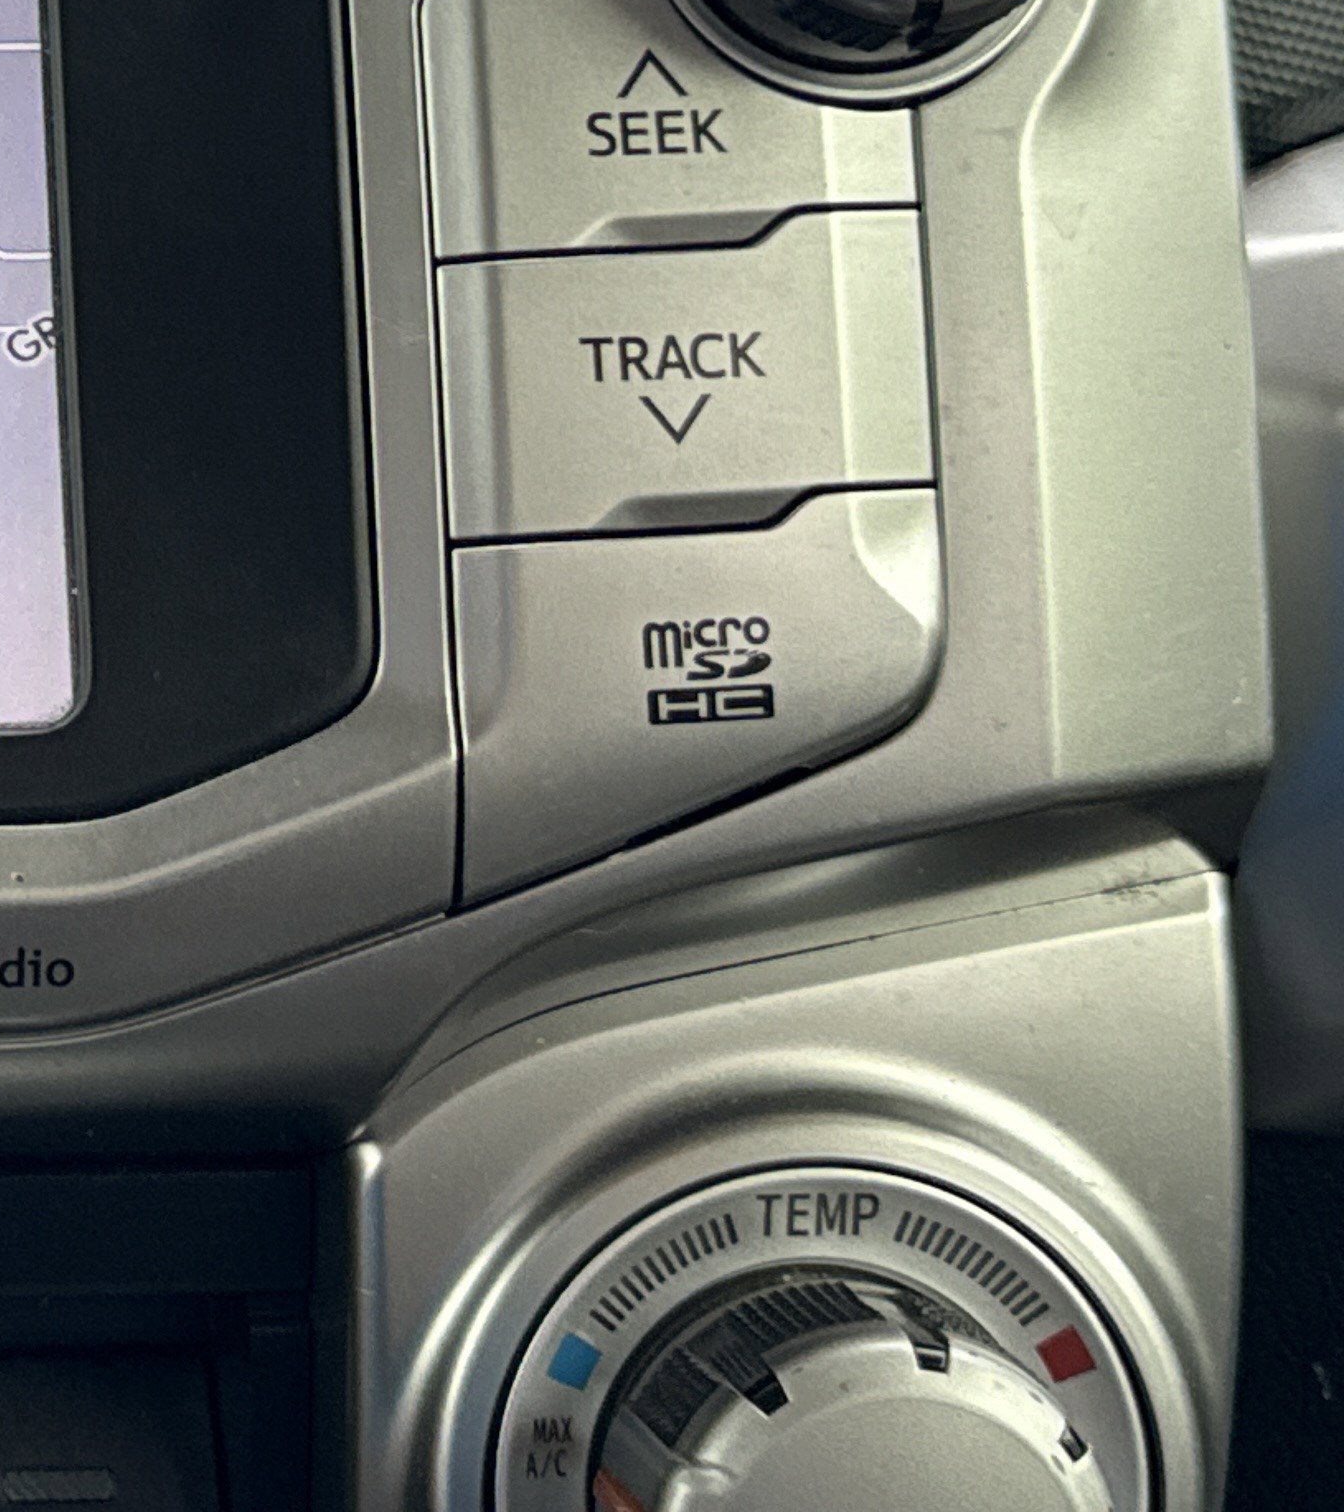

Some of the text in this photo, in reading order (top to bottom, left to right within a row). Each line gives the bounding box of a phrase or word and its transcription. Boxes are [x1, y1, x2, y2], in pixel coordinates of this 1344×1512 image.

[587, 110, 727, 157] SEEK
[579, 332, 766, 382] TRACK
[642, 616, 771, 670] micro
[756, 1192, 880, 1238] TEMP
[533, 1416, 573, 1444] MAX
[526, 1449, 568, 1480] A/C
